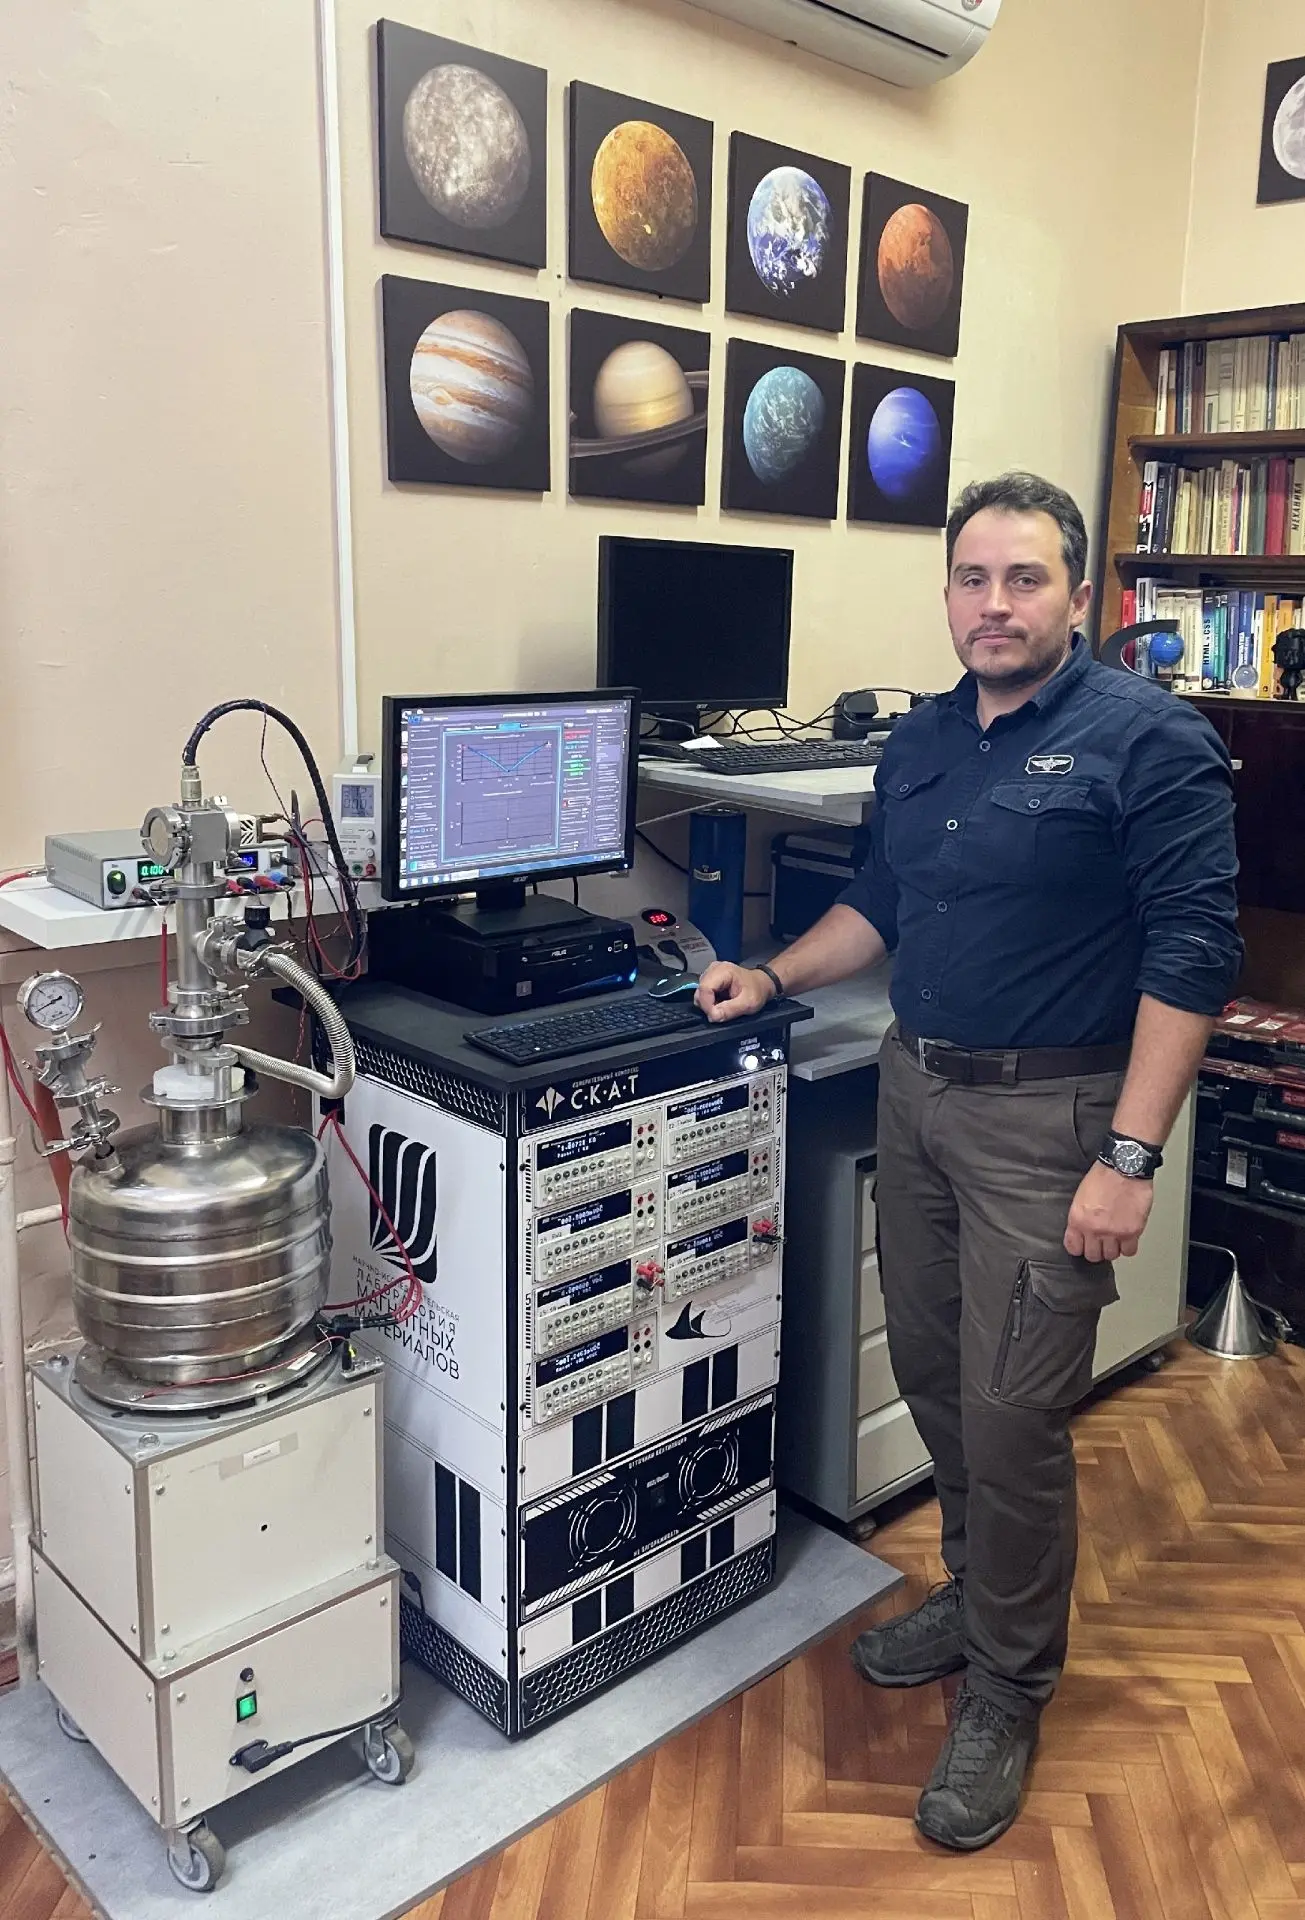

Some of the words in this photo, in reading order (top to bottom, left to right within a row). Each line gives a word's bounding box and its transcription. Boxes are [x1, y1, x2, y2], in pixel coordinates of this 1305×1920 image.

[1291, 483, 1302, 531] МЕХАНИКА
[615, 1066, 640, 1078] КОМПЛЕКС
[776, 1137, 781, 1148] 4
[526, 1144, 531, 1157] 1
[774, 1202, 779, 1213] 6
[525, 1219, 532, 1231] 3
[525, 1293, 532, 1306] 5
[354, 1302, 460, 1380] МЕРИАЛОВ
[525, 1363, 532, 1376] 7
